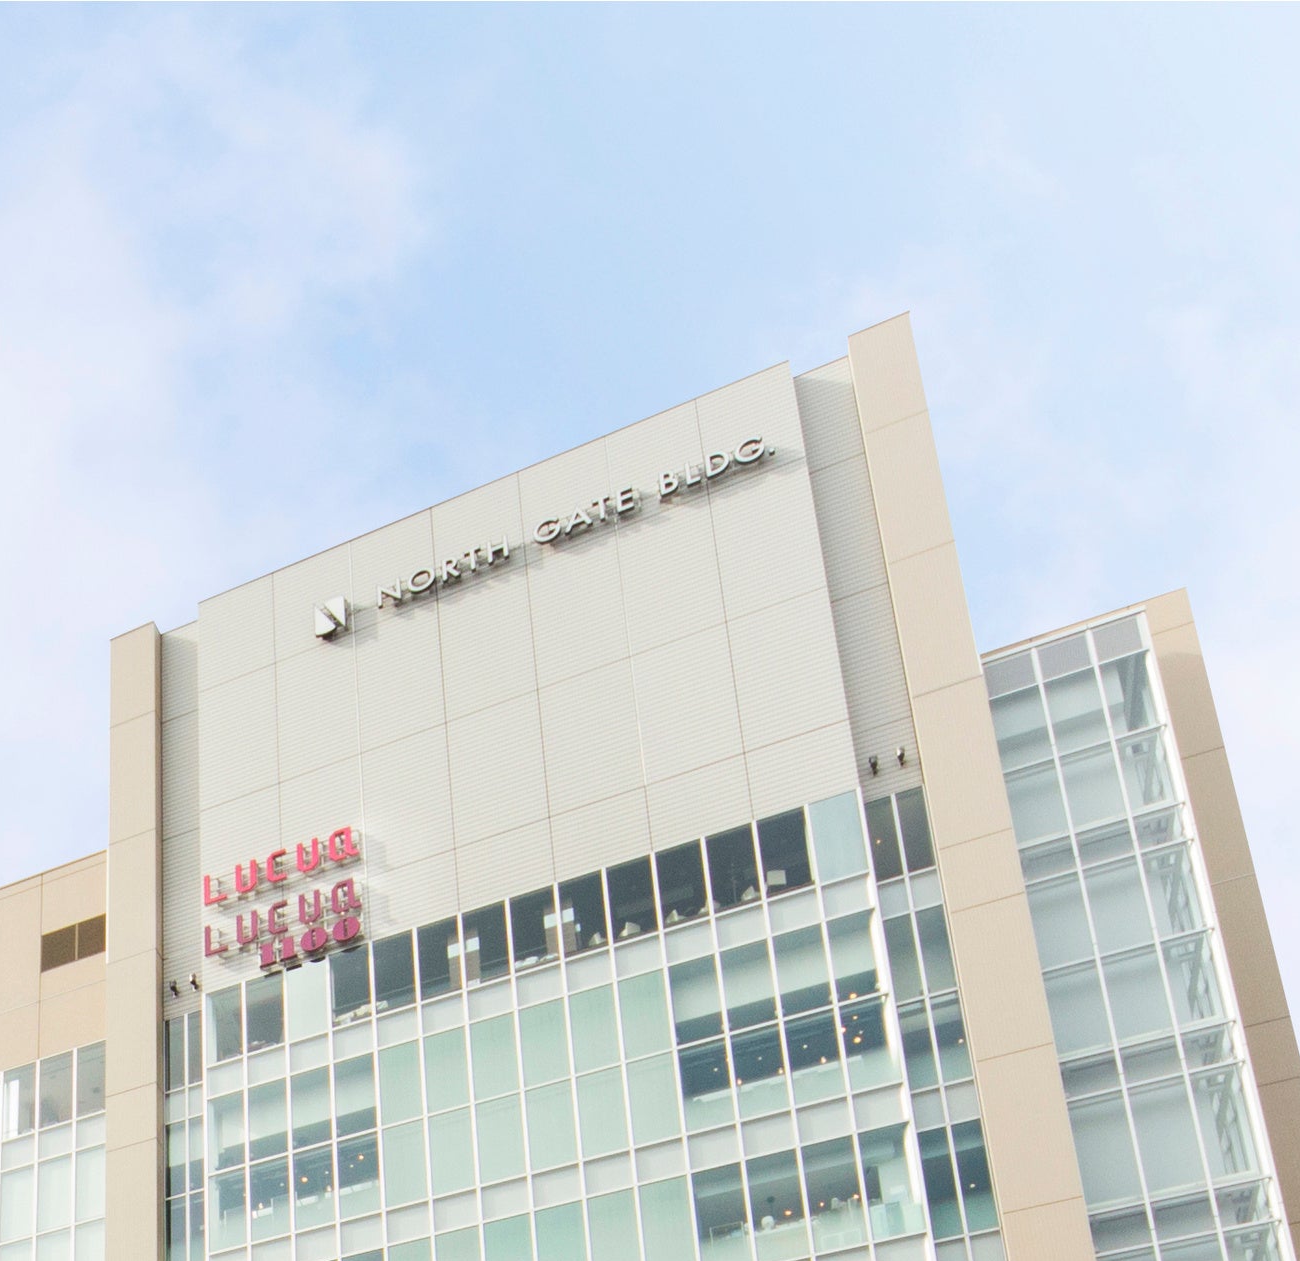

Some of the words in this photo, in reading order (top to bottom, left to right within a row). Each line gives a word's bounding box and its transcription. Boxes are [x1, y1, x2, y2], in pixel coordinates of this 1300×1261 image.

[377, 534, 510, 609] NORTH
[533, 487, 636, 544] GATE
[658, 436, 776, 498] BLDG.
[203, 826, 360, 907] LUCUA
[204, 878, 362, 958] LUCUA
[259, 916, 361, 970] 1100
